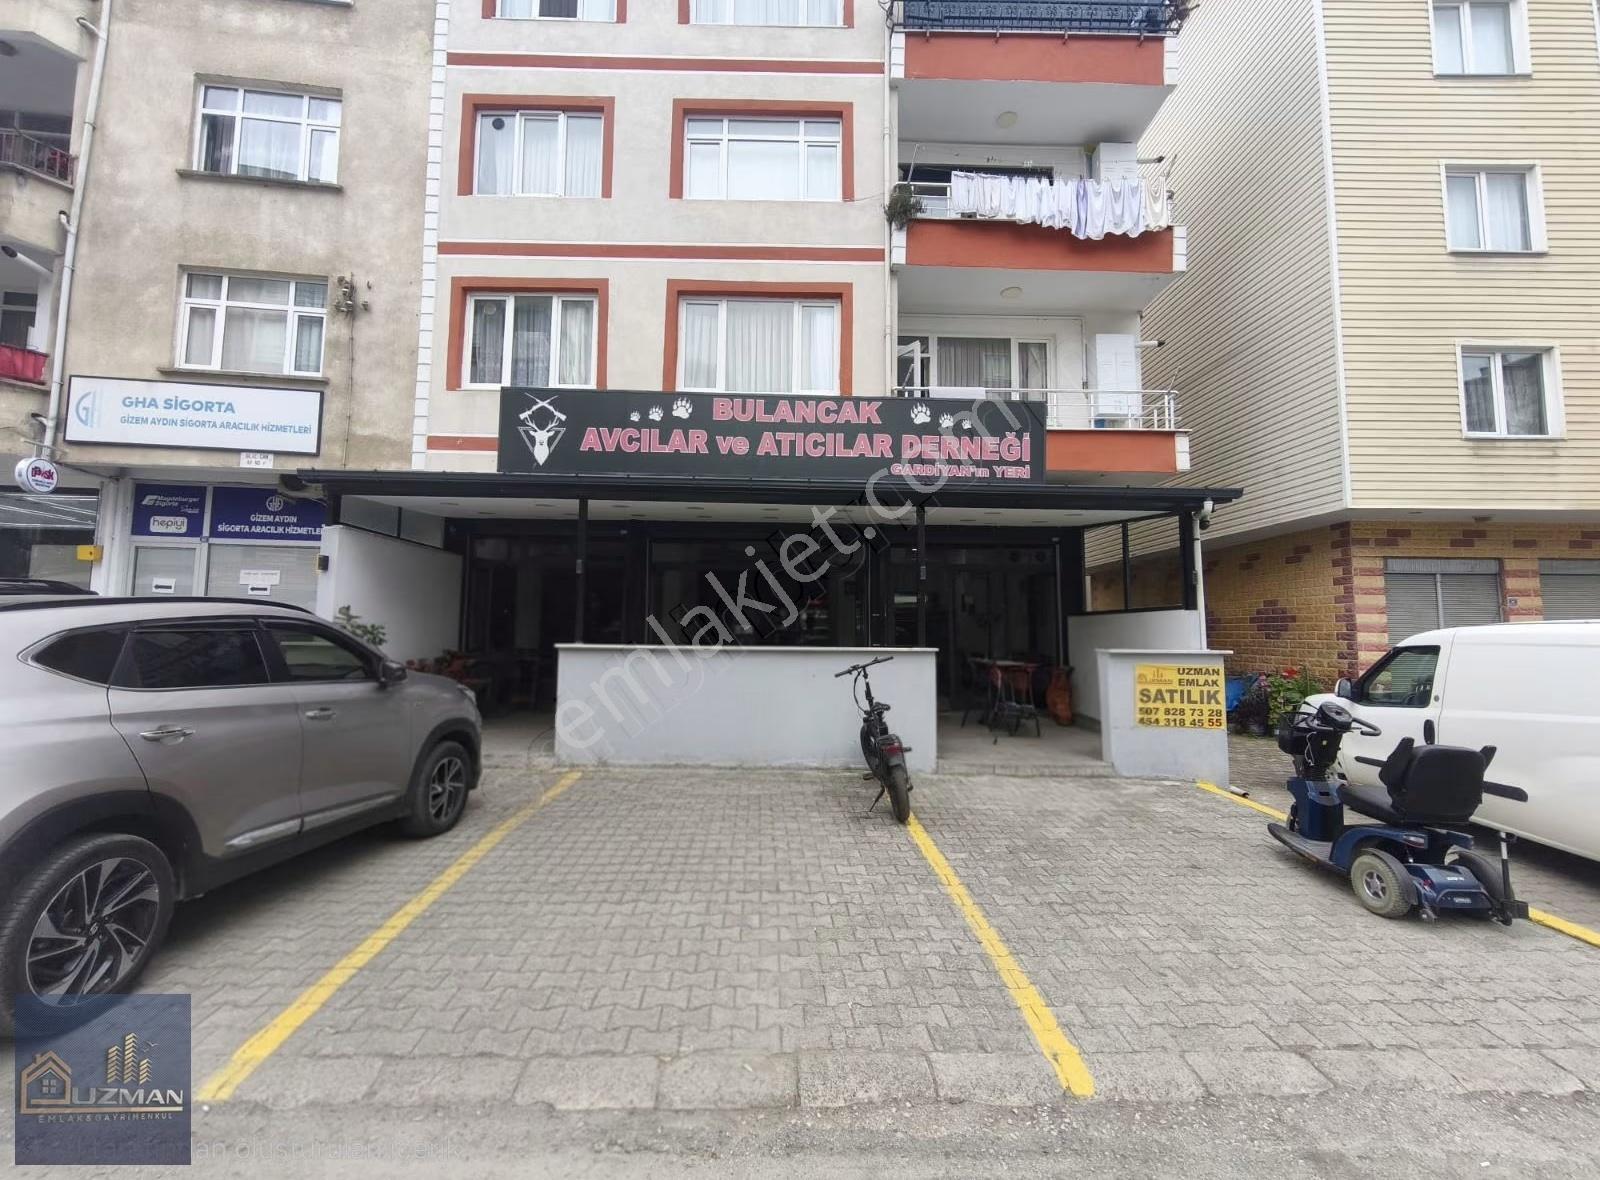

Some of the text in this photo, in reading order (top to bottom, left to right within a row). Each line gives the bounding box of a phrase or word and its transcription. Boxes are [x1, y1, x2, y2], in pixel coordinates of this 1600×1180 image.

[121, 395, 236, 414] GHA SİGORTA
[712, 397, 882, 424] BULANCAK
[120, 415, 312, 434] GİZEM AYDIN SİGORTA ARACILIK HİZMETLERİ
[579, 427, 1031, 461] AVCILAR ve ATICILAR DERNEĞİ
[993, 464, 1031, 479] YERİ
[152, 518, 186, 530] hepiyi
[250, 514, 298, 523] GİZEM AYDIN
[217, 522, 250, 533] SİGORTA
[250, 526, 284, 534] ARACILIK
[1177, 667, 1220, 676] UZMAN
[1178, 678, 1220, 687] EMLAK
[1139, 688, 1221, 705] SATILIK
[1163, 707, 1186, 716] 828
[1189, 708, 1204, 716] 73
[1207, 708, 1222, 717] 28
[1138, 717, 1222, 727] 454 318 45 55
